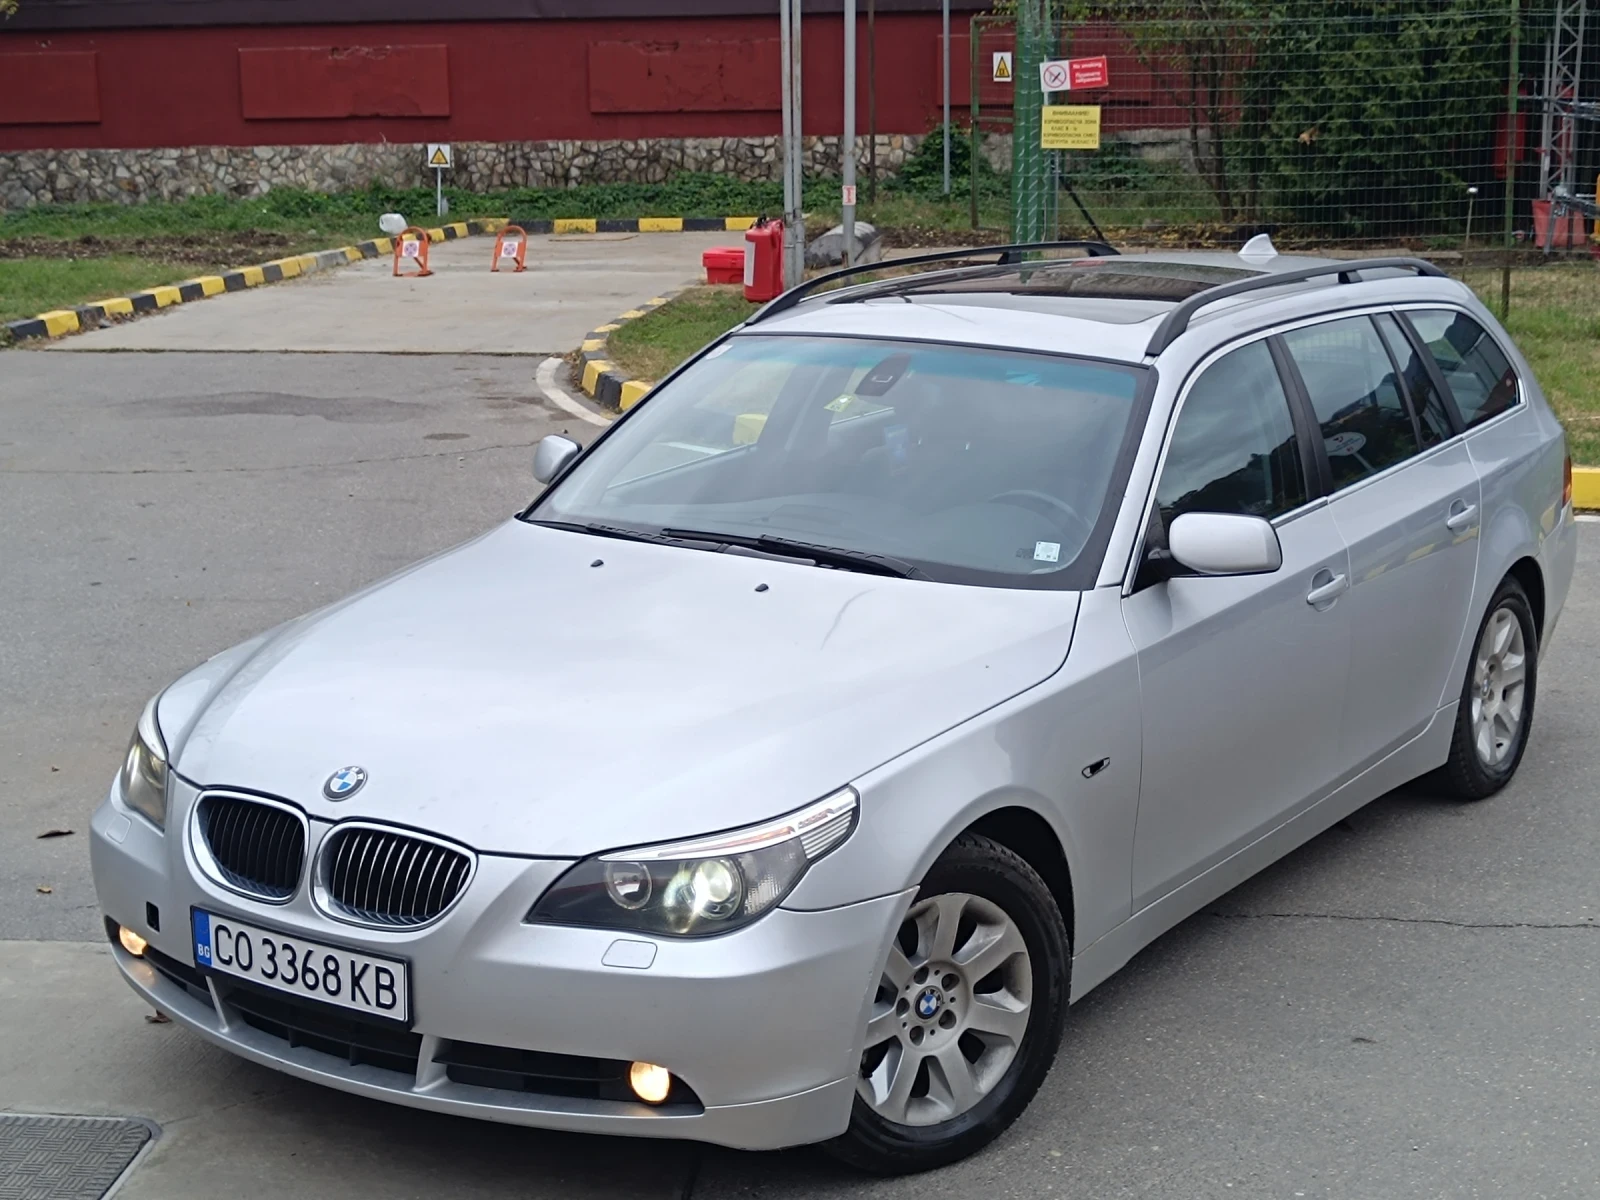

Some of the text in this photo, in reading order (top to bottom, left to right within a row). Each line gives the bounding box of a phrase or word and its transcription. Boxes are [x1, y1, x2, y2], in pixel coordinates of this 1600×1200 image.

[197, 943, 211, 959] BG
[214, 924, 397, 1010] CO 3368 KB
